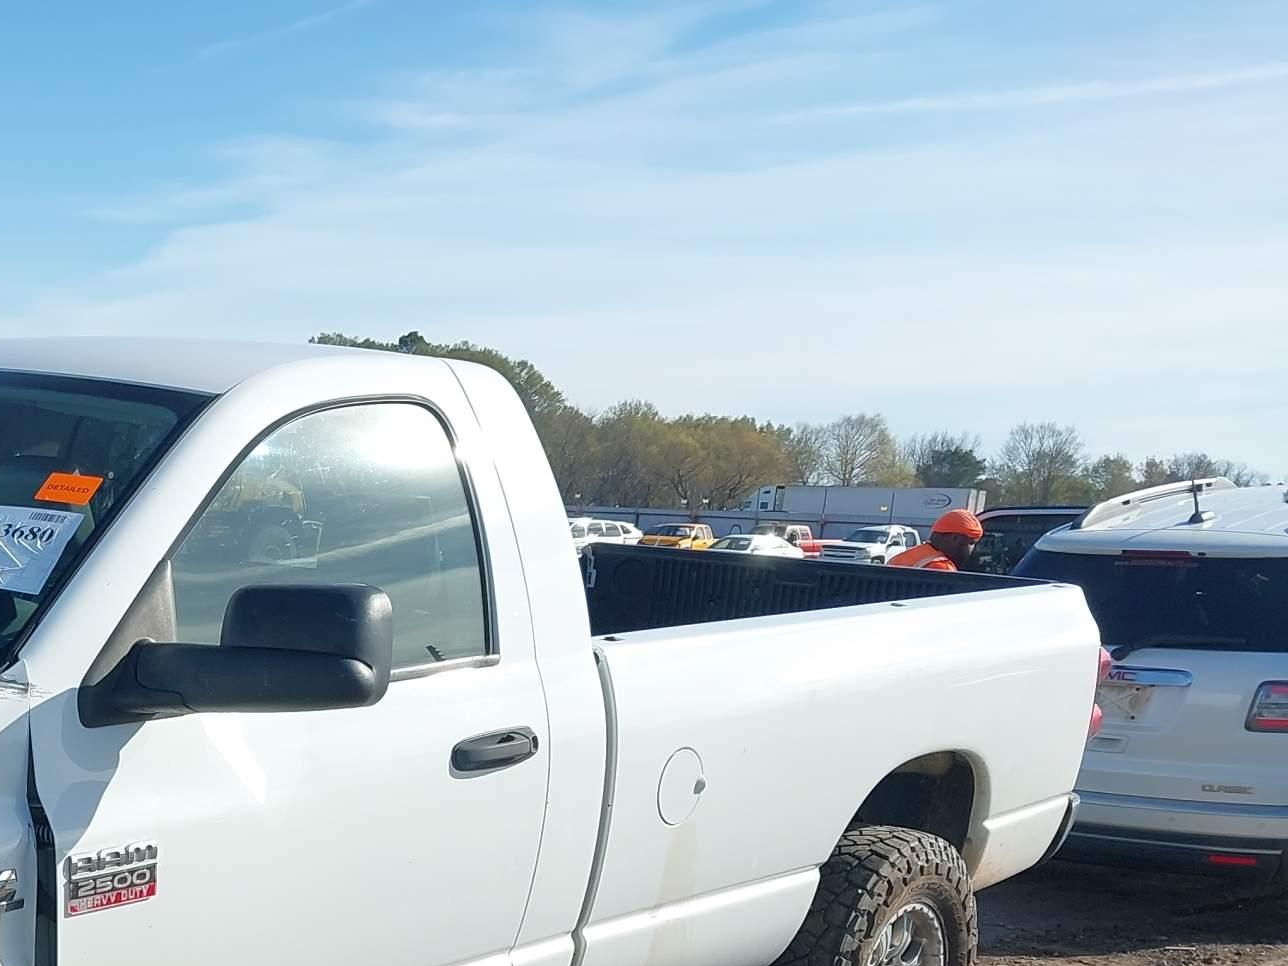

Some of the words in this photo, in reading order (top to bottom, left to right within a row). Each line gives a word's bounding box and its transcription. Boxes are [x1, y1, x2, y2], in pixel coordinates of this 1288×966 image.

[47, 483, 89, 494] DETAILED
[78, 869, 150, 896] 2500
[78, 894, 116, 911] HEAVY
[121, 885, 150, 901] DUTY
